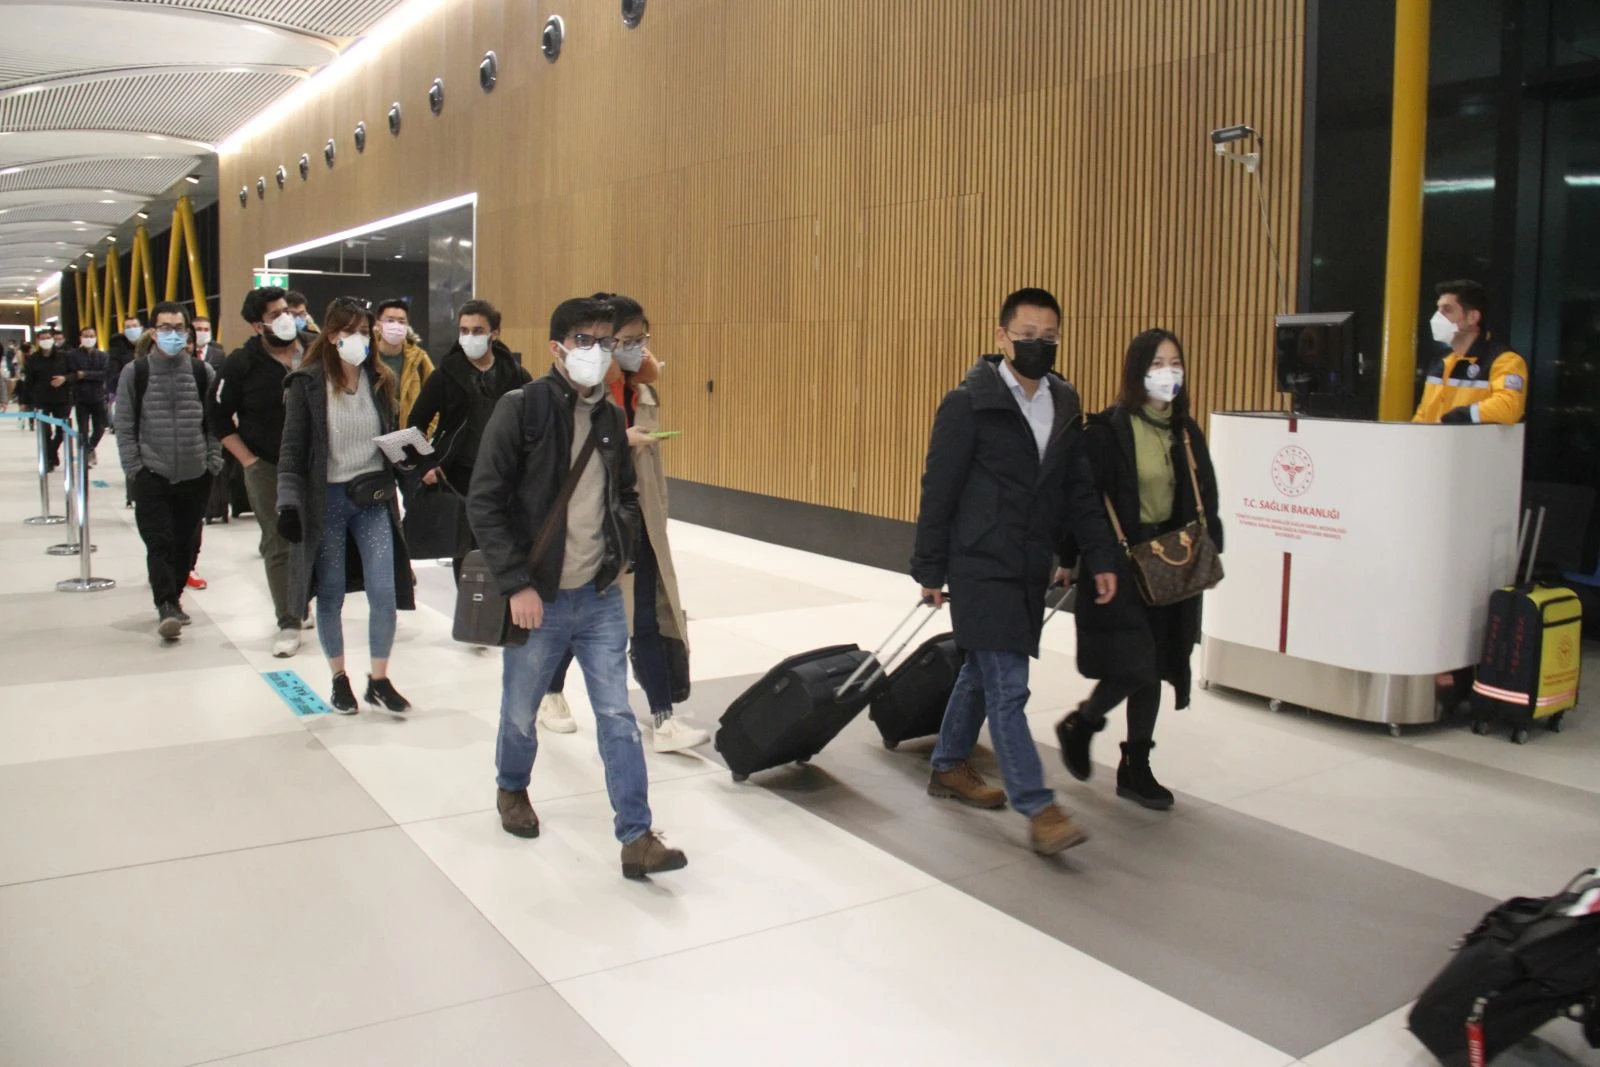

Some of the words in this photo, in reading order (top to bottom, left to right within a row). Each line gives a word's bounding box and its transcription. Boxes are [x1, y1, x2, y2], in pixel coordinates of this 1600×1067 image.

[1243, 498, 1258, 508] T.C.
[1259, 500, 1290, 513] SAĞLIK
[1291, 504, 1340, 520] BAKANLIĞI
